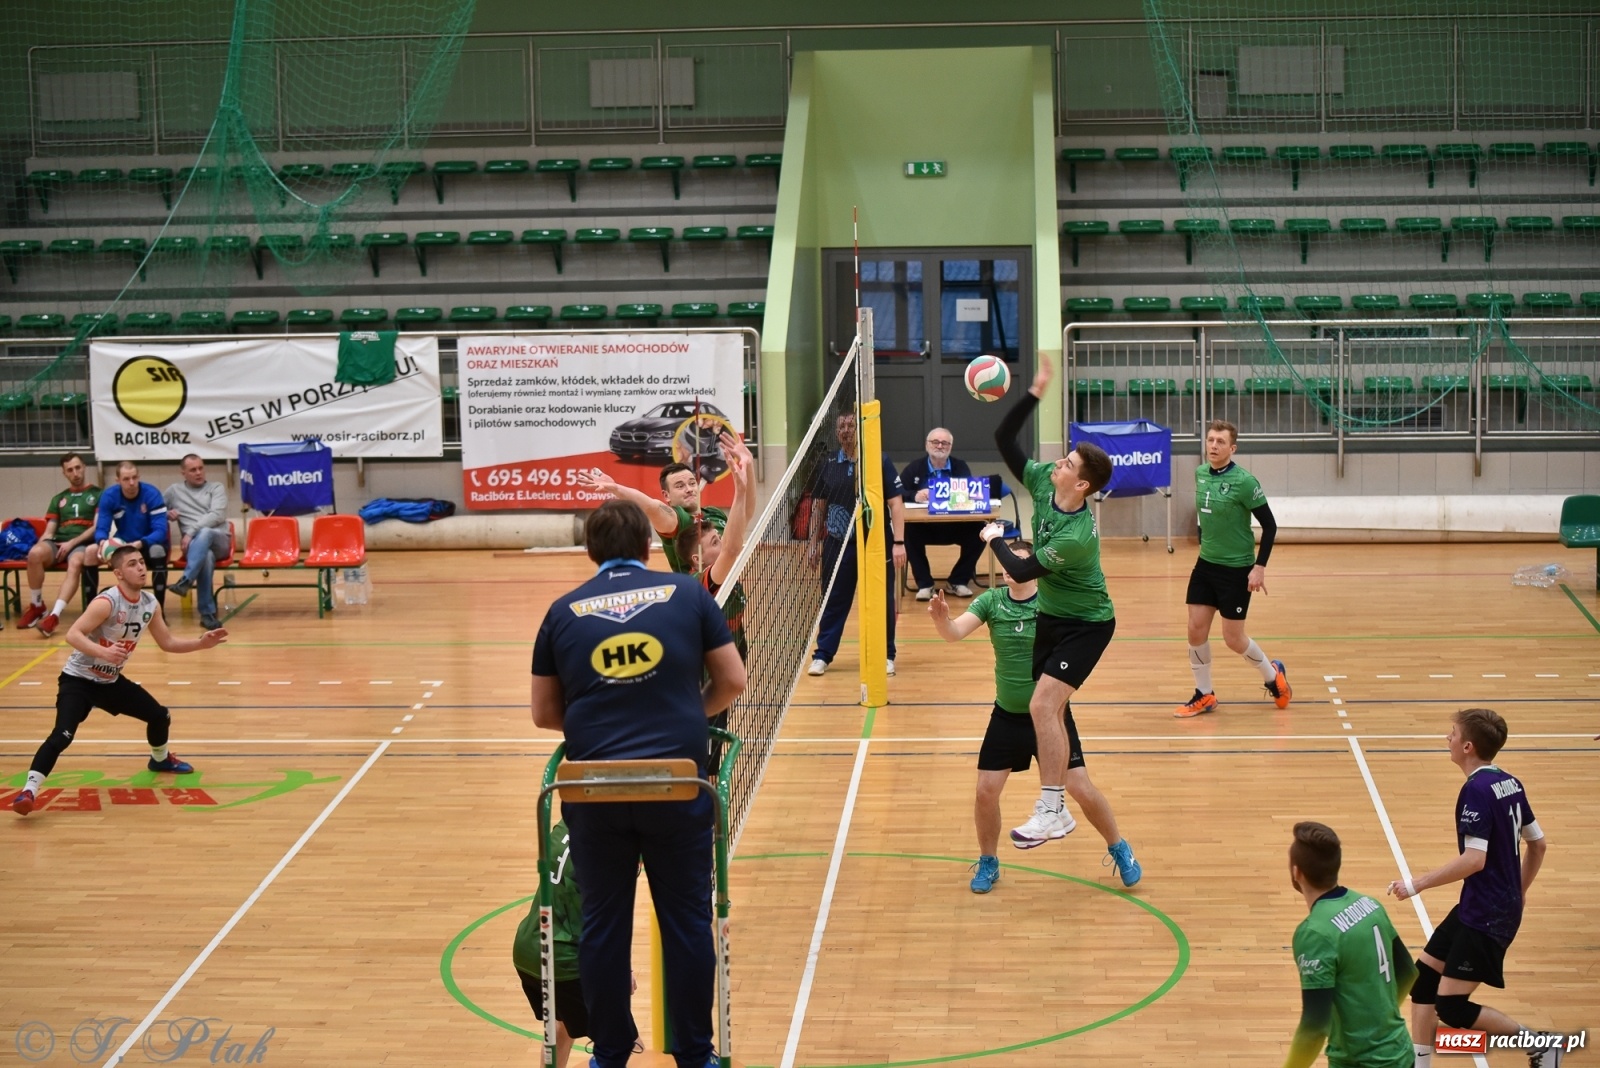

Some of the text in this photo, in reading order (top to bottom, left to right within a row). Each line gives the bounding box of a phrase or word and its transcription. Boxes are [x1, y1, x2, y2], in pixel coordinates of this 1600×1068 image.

[467, 342, 690, 356] AWARYJNE OTWIERANIE SAMOCHODÓW
[467, 356, 559, 370] ORAZ MIESZKAŃ
[467, 374, 690, 388] Sprzedaż zamków, kłódek, wkładek do drzwi
[467, 389, 511, 399] (oferujemy
[513, 388, 547, 397] również
[549, 388, 579, 397] montaż
[585, 388, 622, 397] wymianę
[623, 387, 658, 396] zamków
[659, 388, 677, 396] oraz
[678, 387, 717, 397] wkładek)
[468, 403, 637, 415] Dorabianie oraz kodowanie kluczy
[205, 407, 255, 439] JEST
[261, 398, 283, 420] W
[468, 417, 597, 430] i pilotów samochodowych
[114, 428, 192, 446] RACIBÓRZ
[291, 429, 425, 443] www.osir-raciborz.pl
[267, 470, 323, 487] molten
[487, 468, 523, 487] 695
[527, 468, 563, 487] 496
[470, 490, 515, 502] Racibórz
[516, 489, 561, 502] E.Leclerc
[562, 490, 575, 501] ul.
[935, 481, 950, 498] 23
[969, 480, 984, 499] 21
[579, 587, 667, 614] TWINPIGS
[602, 641, 652, 670] HK
[1372, 924, 1391, 983] 4
